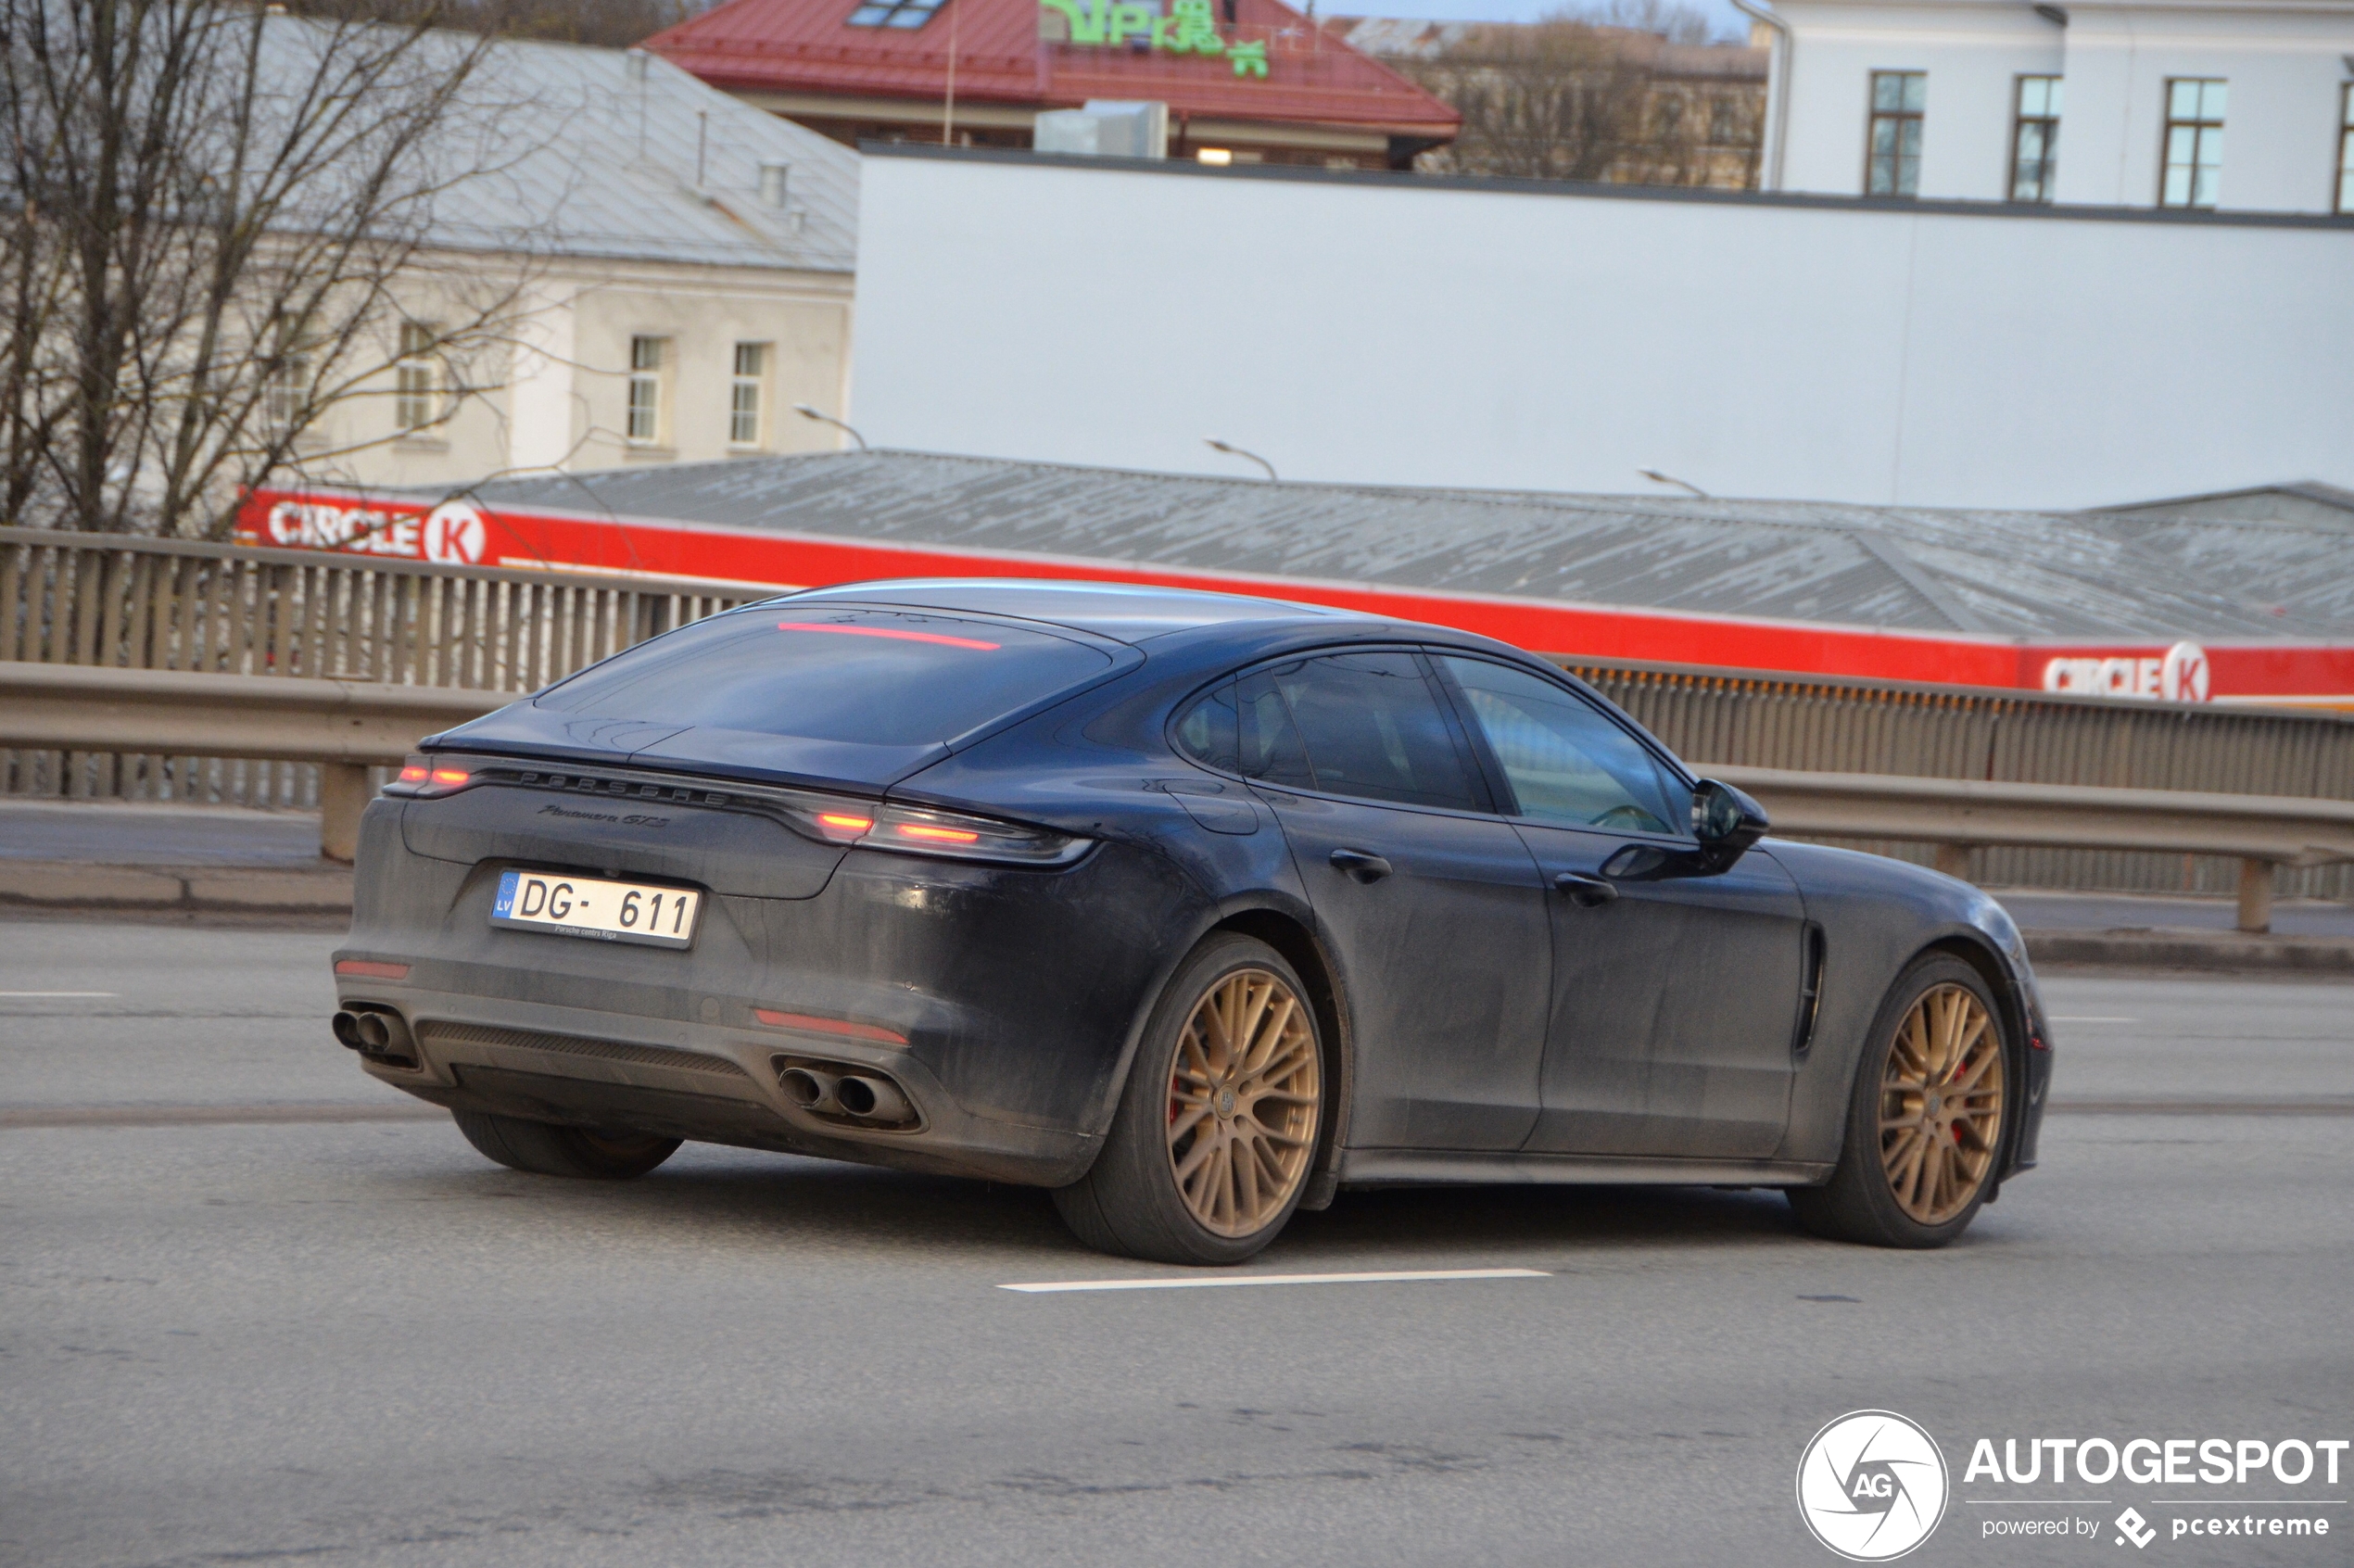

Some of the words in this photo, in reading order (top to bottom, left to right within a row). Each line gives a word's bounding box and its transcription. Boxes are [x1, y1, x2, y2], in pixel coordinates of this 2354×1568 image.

[268, 501, 421, 556] CIRCLE
[440, 516, 474, 563] K
[2044, 657, 2161, 701] CIRCLE
[2178, 657, 2204, 702] K
[520, 772, 729, 806] PORSCHE
[538, 804, 618, 822] Panamera
[622, 815, 671, 828] GTS
[497, 900, 512, 911] LV
[619, 891, 687, 933] 611
[555, 925, 580, 935] Porsche
